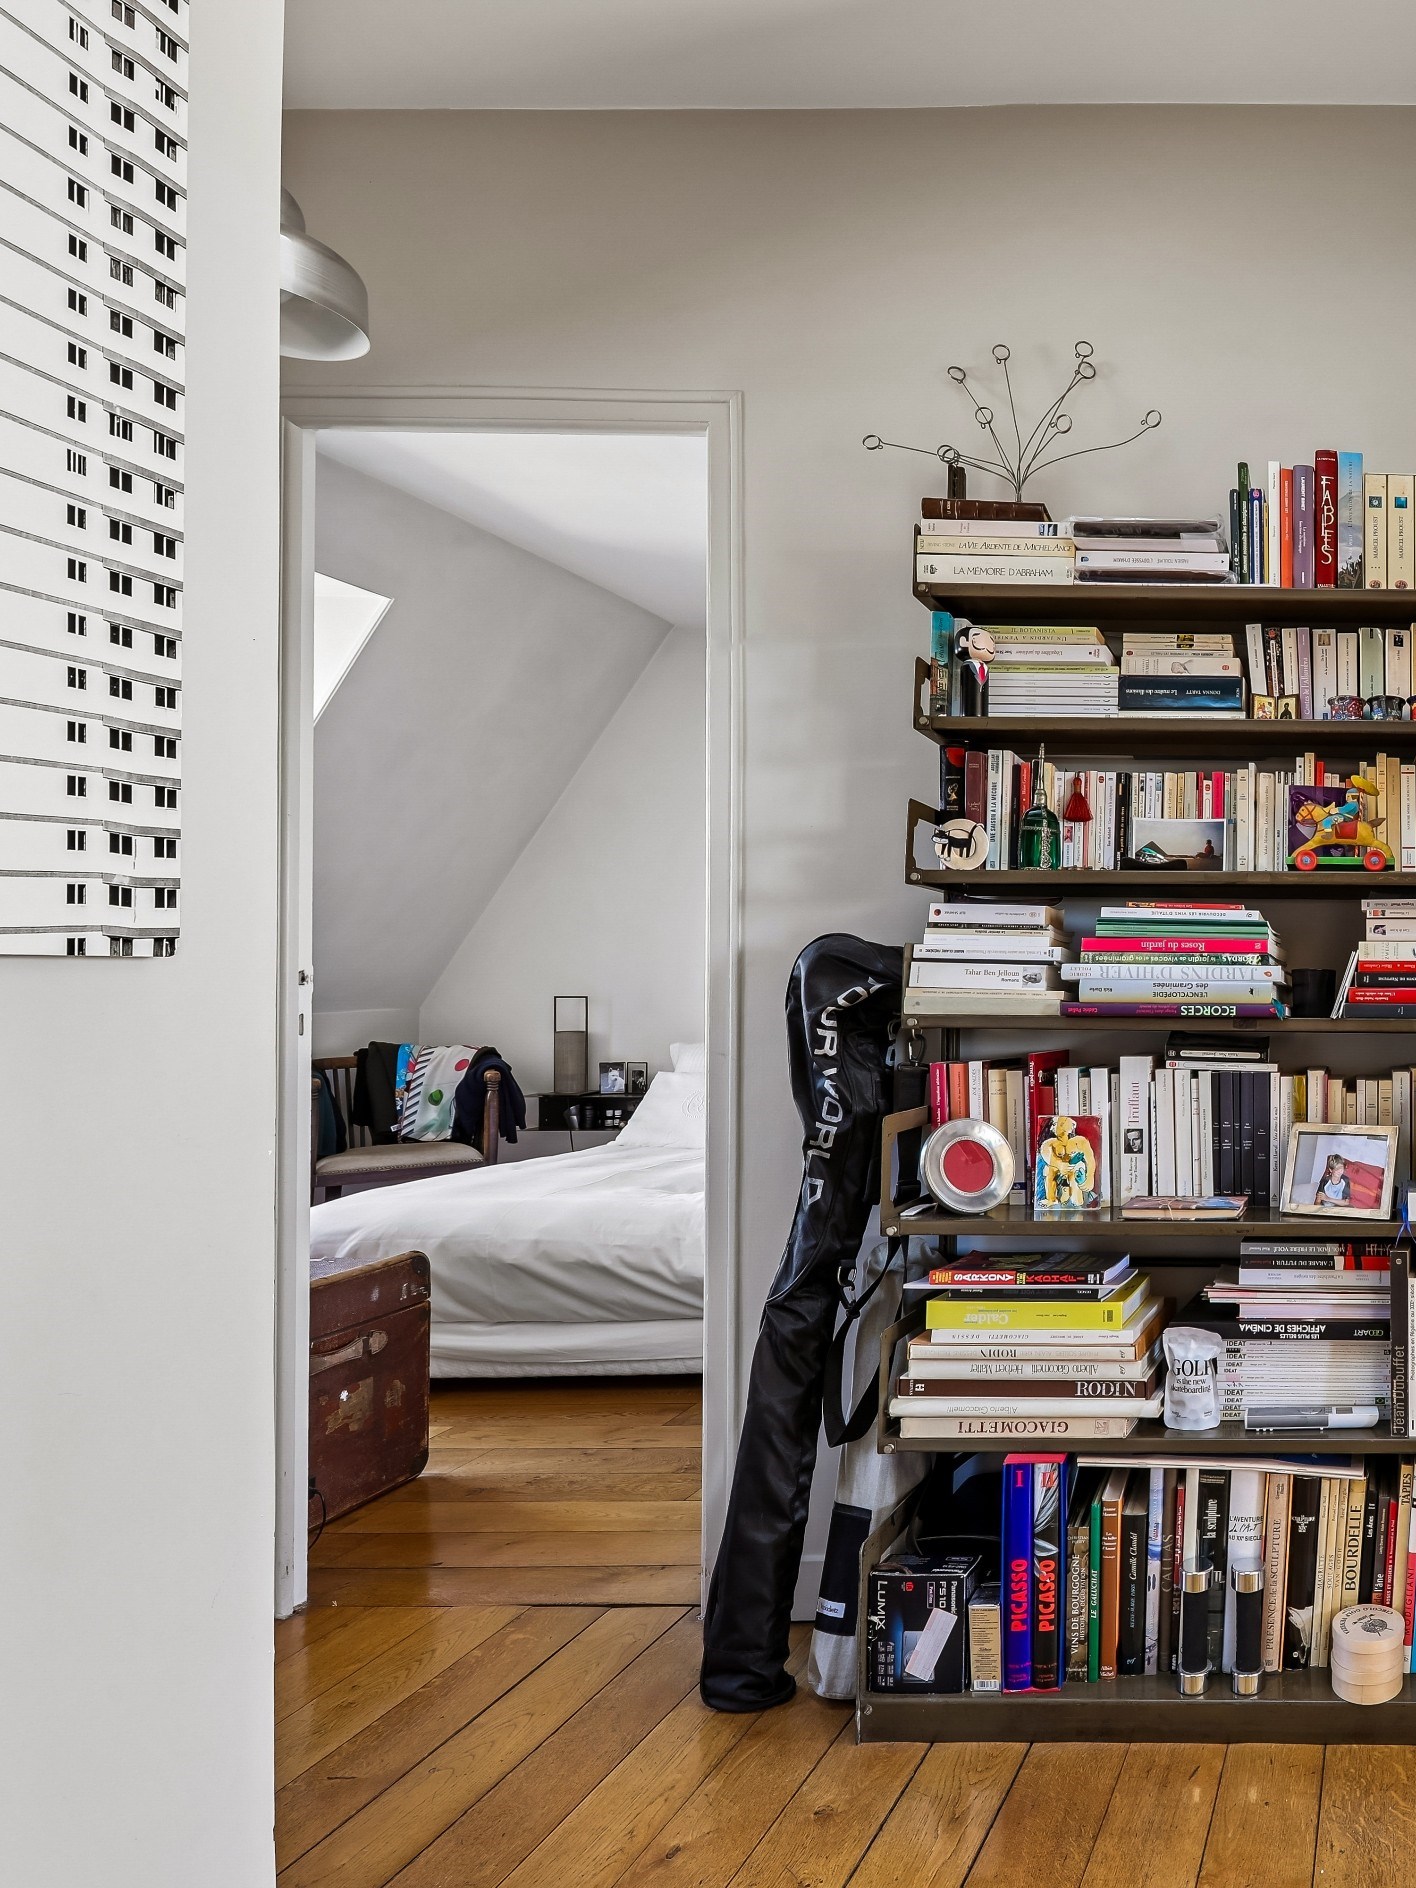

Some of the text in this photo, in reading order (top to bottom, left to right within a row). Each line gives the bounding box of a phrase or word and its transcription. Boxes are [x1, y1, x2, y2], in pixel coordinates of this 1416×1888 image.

[1320, 475, 1334, 565] FABLES
[967, 541, 979, 549] VIE
[980, 542, 1011, 550] ARDENTE
[953, 565, 1054, 577] LA MÉMOIRE D'ABRAHAM
[990, 781, 998, 801] MECQUE
[1141, 940, 1206, 951] Roses du jardin
[964, 968, 1020, 978] Tahar Ben Jelloun
[1099, 966, 1258, 979] JARDINS D'HIVER
[1152, 982, 1209, 990] des Graminées
[1152, 990, 1209, 999] L'ENCYCLOPÉDIE
[1181, 1005, 1237, 1016] ÉCORCES
[1127, 1081, 1140, 1127] Truffaut
[806, 1067, 843, 1206] WORLD
[953, 1273, 1015, 1282] SARKOZY
[1025, 1274, 1084, 1284] KADHAFI
[964, 1313, 1009, 1325] Calder
[1238, 1323, 1326, 1333] AFFICHES DE CINÉMA
[980, 1349, 1017, 1358] RODIN
[970, 1363, 1100, 1374] Alberto Giacometti Herbert Matter
[1393, 1346, 1405, 1399] Dubuffet
[1074, 1381, 1137, 1397] RODIN
[947, 1405, 1019, 1414] Alberto Giacometti
[1393, 1402, 1405, 1434] Jean
[958, 1420, 1070, 1434] GIACOMETTI
[1400, 1473, 1412, 1506] TÀPIES
[1204, 1499, 1218, 1530] sculpture
[1366, 1515, 1374, 1538] Les Ânes
[1128, 1532, 1138, 1581] Camille Claudel
[1345, 1505, 1362, 1592] BOURDELLE
[1161, 1535, 1173, 1593] CALLAS
[939, 1581, 947, 1608] FS10
[1010, 1559, 1028, 1631] PICASSO
[1038, 1559, 1056, 1631] PICASSO
[1090, 1570, 1098, 1619] LE GALUCHAT
[1265, 1518, 1281, 1650] PRÉSENCE de la SCULPTURE
[1374, 1573, 1384, 1603] de l'âne
[878, 1580, 888, 1630] LUMIX
[950, 1581, 958, 1615] Panasonic
[1070, 1555, 1080, 1654] VINS DE BOURGOGNE
[1405, 1568, 1415, 1637] MODIGLIANI
